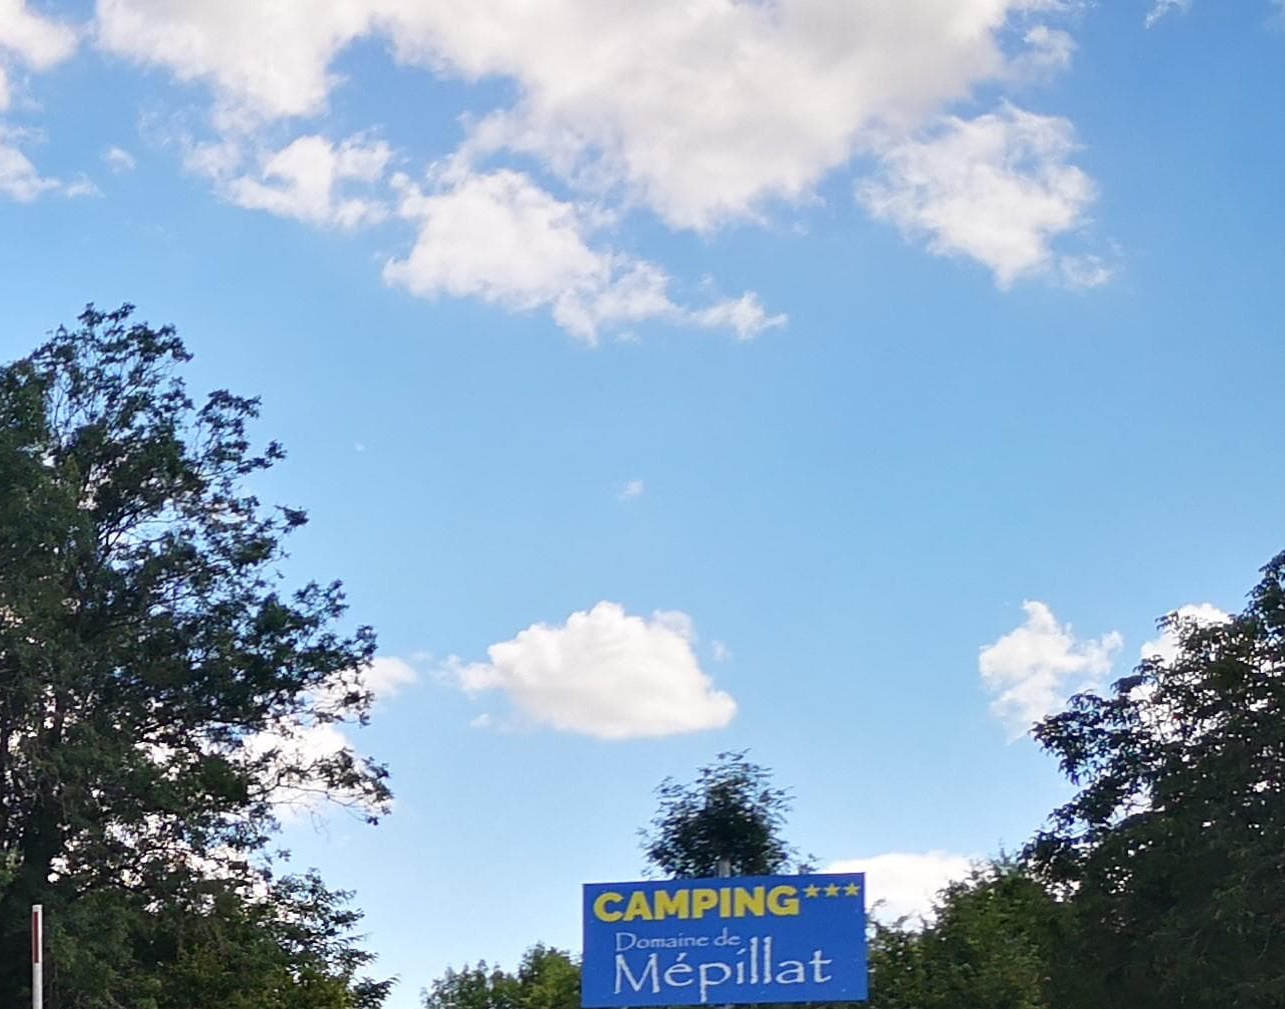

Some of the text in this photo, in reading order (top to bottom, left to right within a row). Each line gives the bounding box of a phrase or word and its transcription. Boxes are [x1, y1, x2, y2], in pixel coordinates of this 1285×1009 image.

[594, 886, 800, 922] CAMPING
[615, 927, 741, 951] Domaine de
[614, 936, 833, 1003] Mépillat
